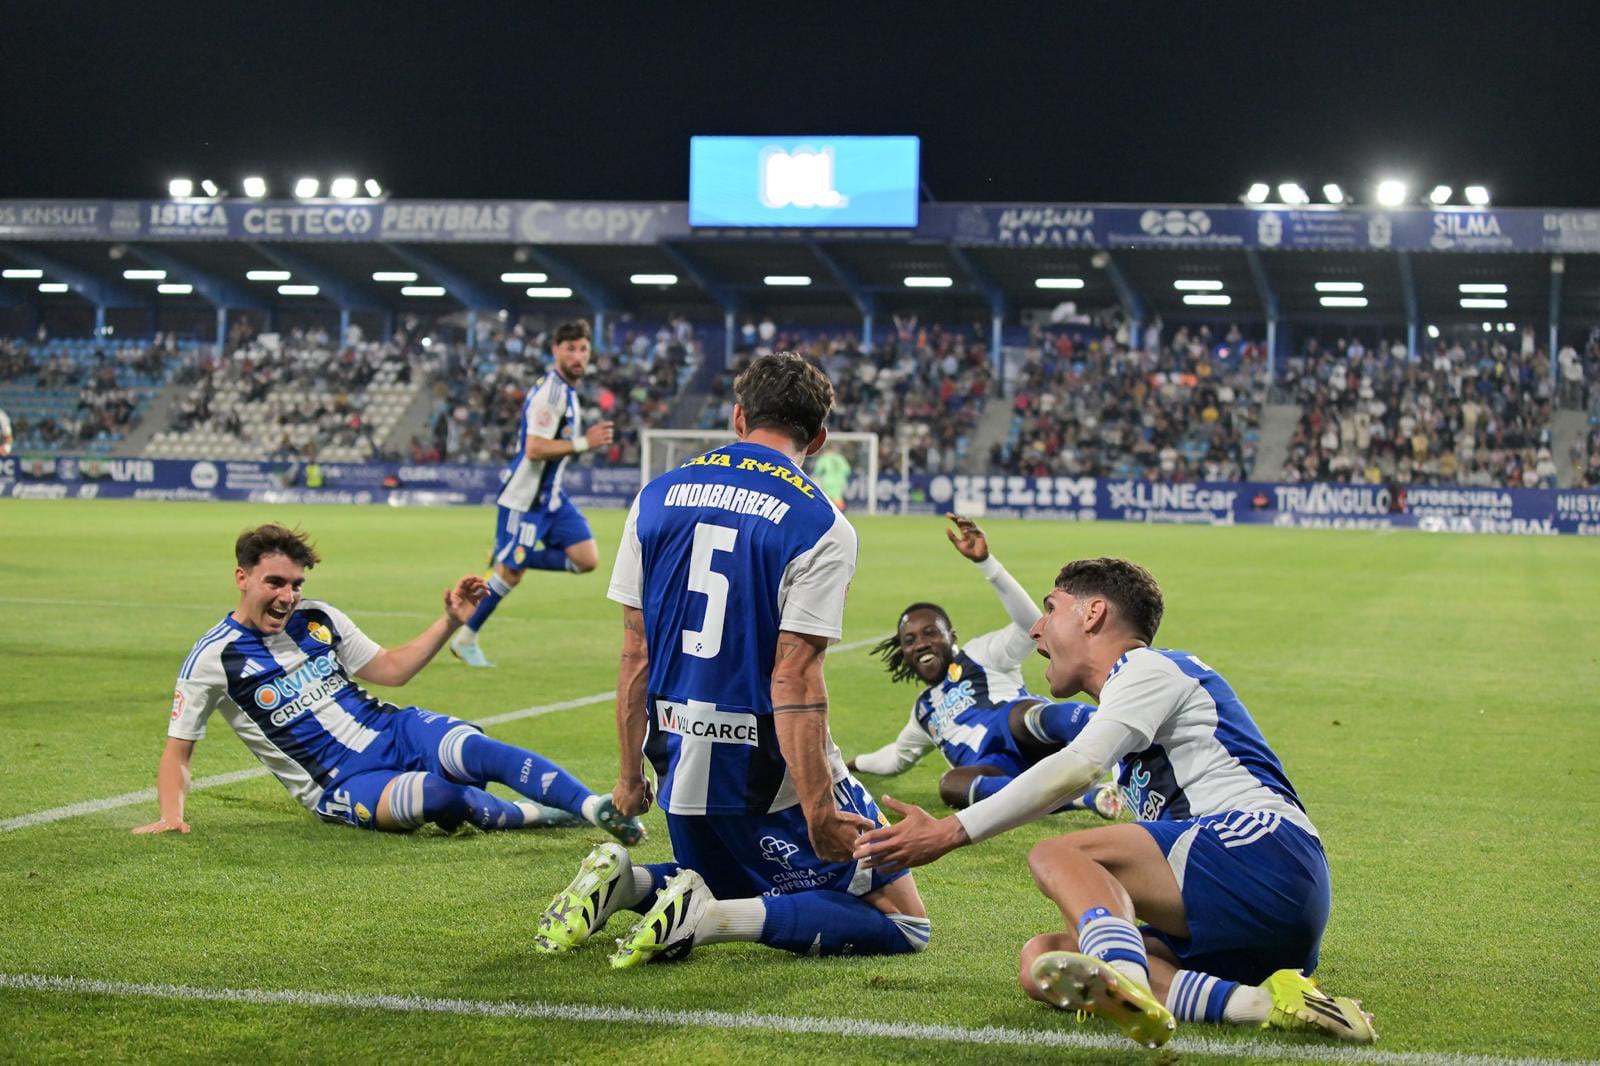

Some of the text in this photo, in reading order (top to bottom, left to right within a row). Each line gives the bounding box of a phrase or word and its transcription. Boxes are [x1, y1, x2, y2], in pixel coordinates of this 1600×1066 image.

[150, 204, 228, 226] ISECA
[243, 208, 372, 234] CETECO
[381, 205, 510, 231] PERYBRAS
[1433, 213, 1501, 236] SILMA
[680, 453, 732, 468] AJA
[664, 483, 791, 525] UNDABARRENA
[953, 475, 1097, 506] KILIM
[682, 522, 738, 659] 5
[272, 675, 346, 725] CRICURSA
[677, 715, 757, 742] VALCARCE
[519, 757, 533, 784] SDP
